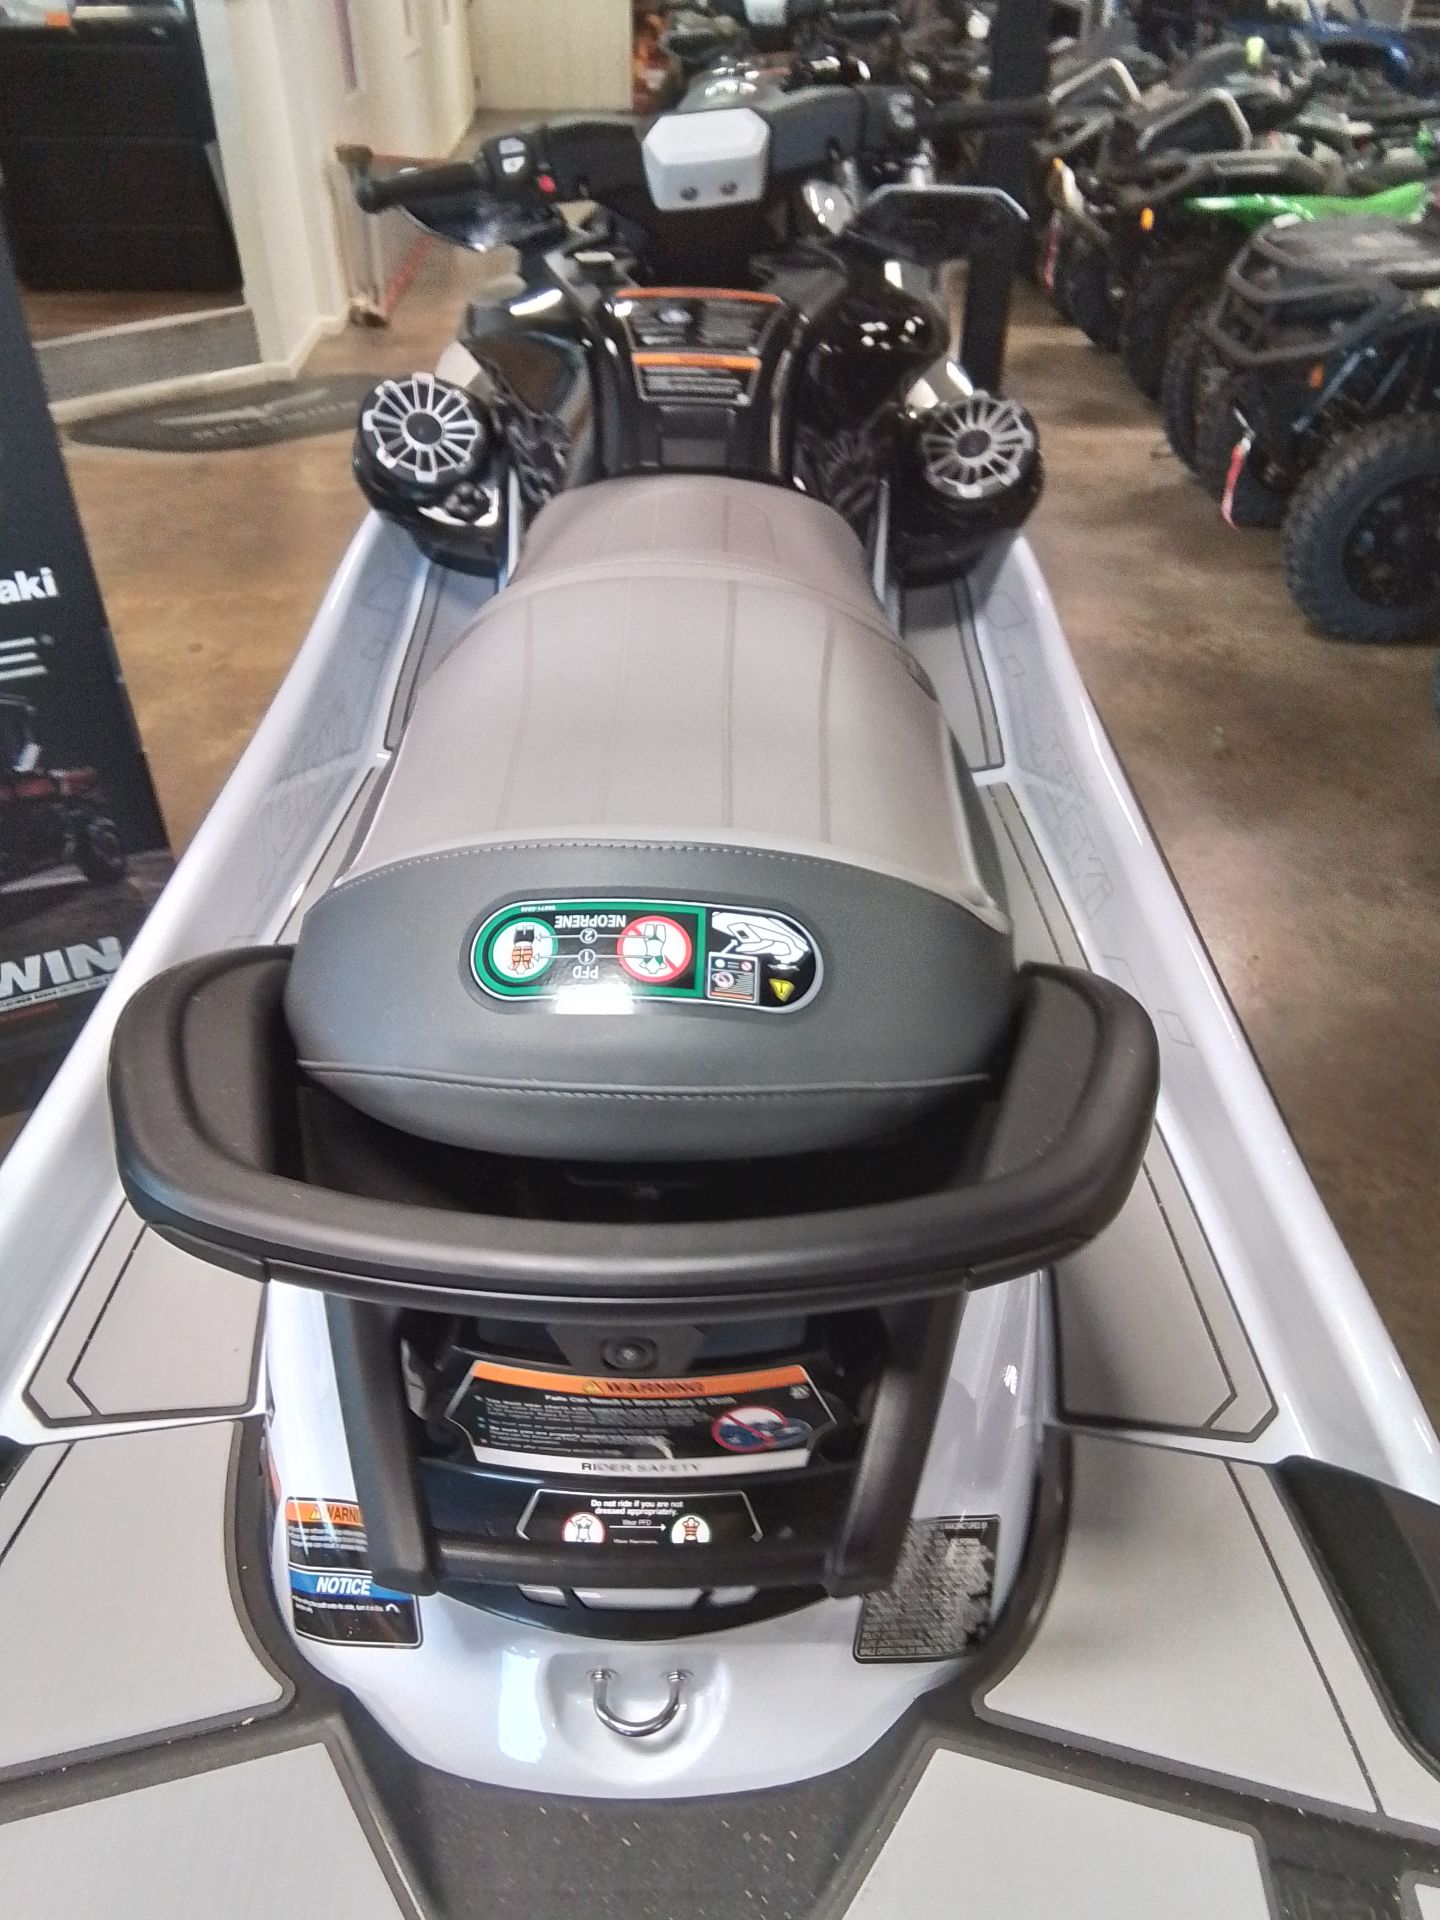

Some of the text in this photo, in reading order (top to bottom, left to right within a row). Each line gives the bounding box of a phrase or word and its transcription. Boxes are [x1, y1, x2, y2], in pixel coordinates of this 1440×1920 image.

[554, 914, 627, 928] NEOPRENE
[572, 965, 599, 979] PFD
[581, 1462, 700, 1473] RIDER SAFETY
[590, 1499, 602, 1508] Do
[603, 1500, 617, 1508] not
[618, 1500, 633, 1508] ride
[634, 1500, 640, 1508] if
[640, 1501, 656, 1509] you
[670, 1500, 684, 1508] not
[594, 1507, 626, 1515] dressed
[316, 1576, 373, 1595] NOTICE
